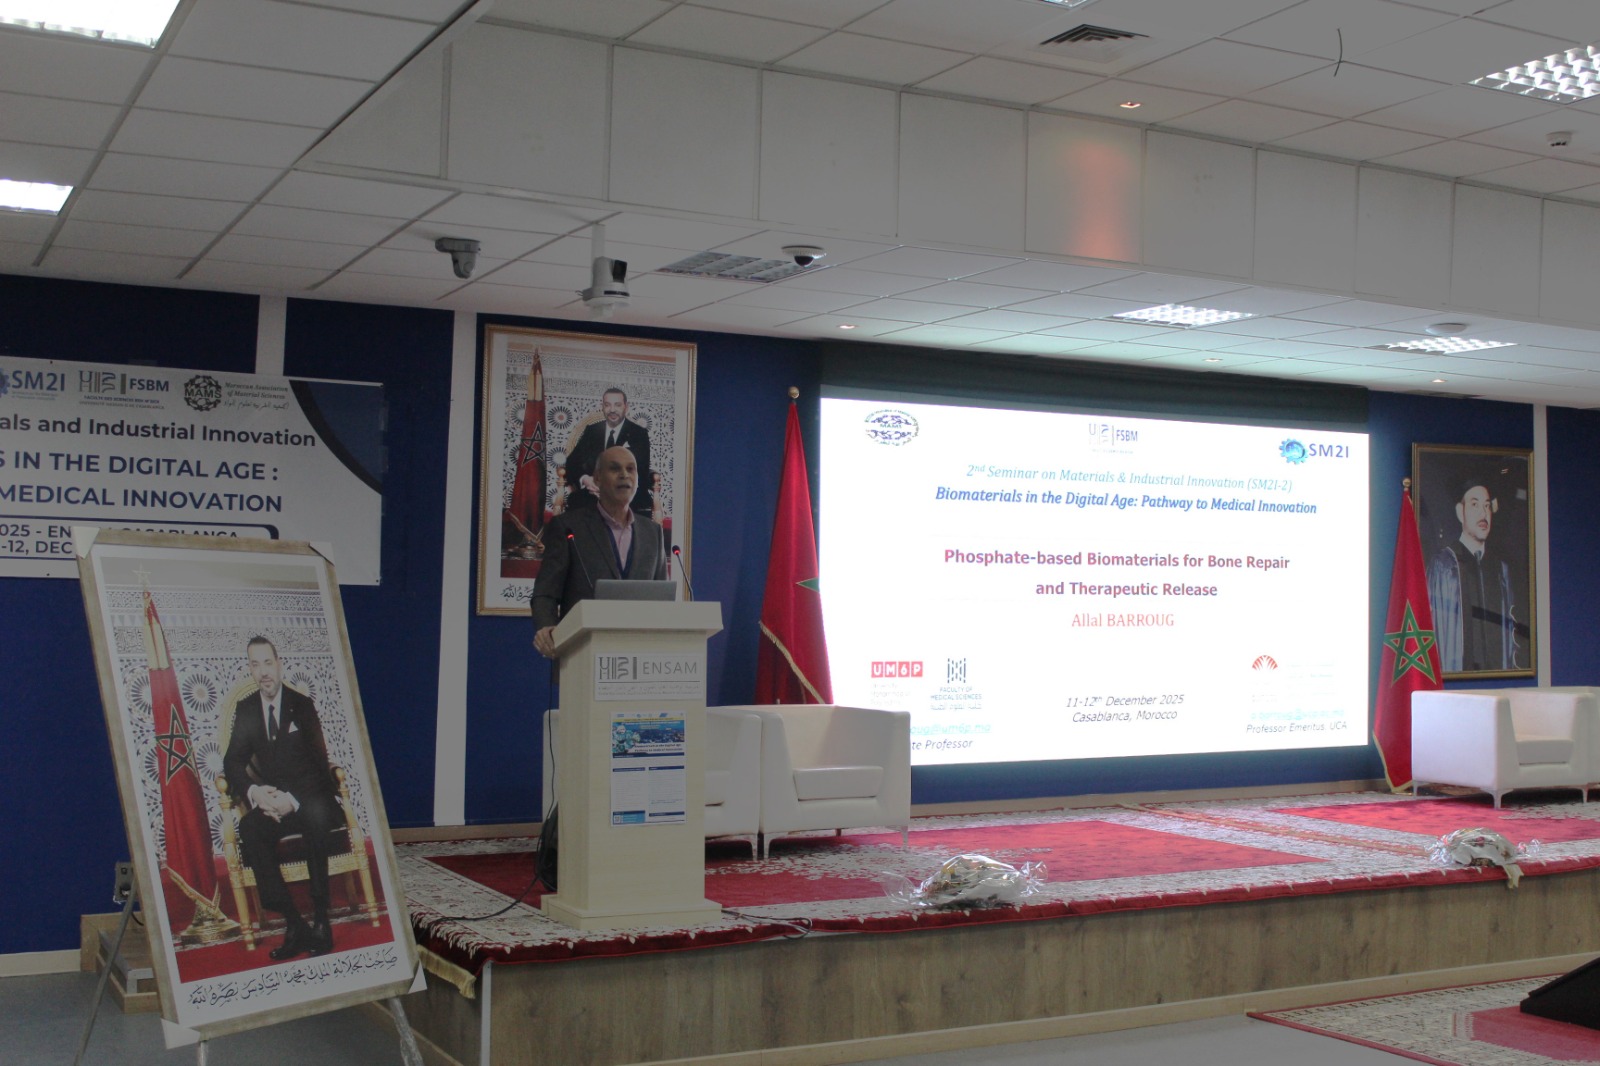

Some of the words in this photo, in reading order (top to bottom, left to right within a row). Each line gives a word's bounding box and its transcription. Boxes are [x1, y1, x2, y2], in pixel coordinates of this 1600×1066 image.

[11, 370, 66, 392] SM2I
[129, 378, 170, 392] FSBM
[184, 387, 222, 400] MAMS
[38, 417, 81, 434] and
[89, 418, 195, 440] Industrial
[202, 422, 316, 447] Innovation
[1115, 428, 1138, 443] FSBM
[1308, 442, 1349, 459] SM2I
[15, 451, 40, 470] IN
[49, 453, 100, 473] THE
[109, 455, 208, 478] DIGITAL
[987, 465, 1039, 480] Seminar
[1041, 472, 1056, 481] on
[1059, 470, 1115, 484] Materials
[1117, 472, 1127, 483] &
[1129, 473, 1184, 486] Industrial
[1187, 475, 1245, 489] Innovation
[0, 484, 115, 506] MEDICAL
[123, 488, 282, 513] INNOVATION
[935, 486, 1022, 503] Biomaterials
[1025, 491, 1038, 503] in
[1041, 491, 1062, 504] the
[1065, 492, 1109, 509] Digital
[1110, 493, 1138, 510] Age:
[1140, 495, 1193, 512] Pathway
[1196, 498, 1208, 510] to
[1210, 498, 1255, 512] Medical
[1258, 500, 1317, 514] Innovation
[35, 541, 73, 554] DEC
[944, 549, 1082, 567] Phosphate-based
[1087, 552, 1179, 567] Biomaterials
[1183, 554, 1204, 567] for
[1207, 555, 1242, 568] Bone
[1246, 556, 1290, 571] Repair
[1035, 582, 1064, 595] and
[1069, 582, 1158, 599] Therapeutic
[1162, 583, 1218, 596] Release
[1071, 613, 1102, 627] Allal
[1107, 613, 1175, 627] BARROUG
[642, 661, 698, 675] ENSAM
[872, 662, 922, 677] UM6P
[1105, 695, 1157, 707] December
[1159, 694, 1185, 706] 2025
[1072, 711, 1132, 724] Casablanca,
[1135, 710, 1178, 722] Morocco
[1246, 723, 1287, 735] Professor
[1329, 721, 1348, 731] UCA
[924, 739, 974, 752] Professor
